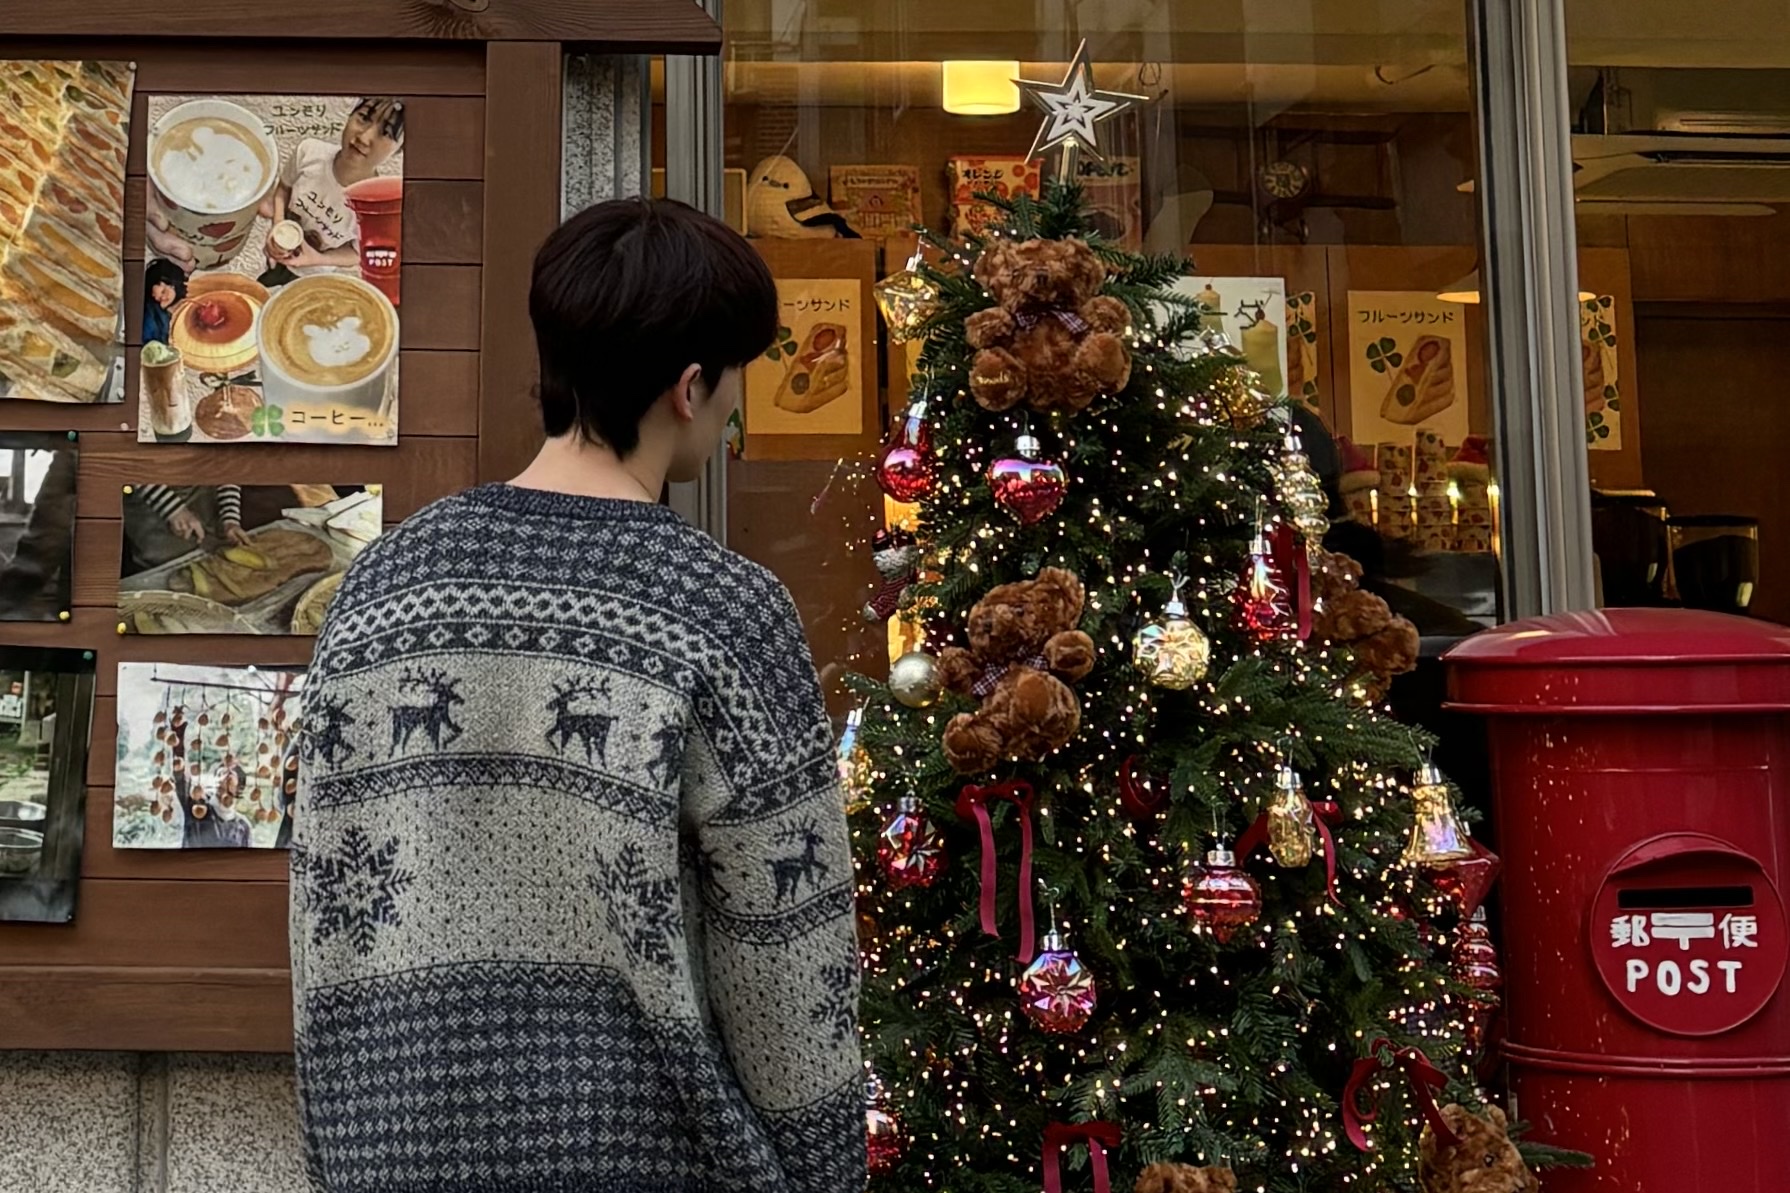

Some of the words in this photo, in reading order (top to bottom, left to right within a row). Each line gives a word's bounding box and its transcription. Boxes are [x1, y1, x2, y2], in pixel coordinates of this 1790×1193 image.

[272, 104, 326, 117] ユンモリ
[783, 298, 850, 312] ーツサンド
[1626, 959, 1743, 996] POST
